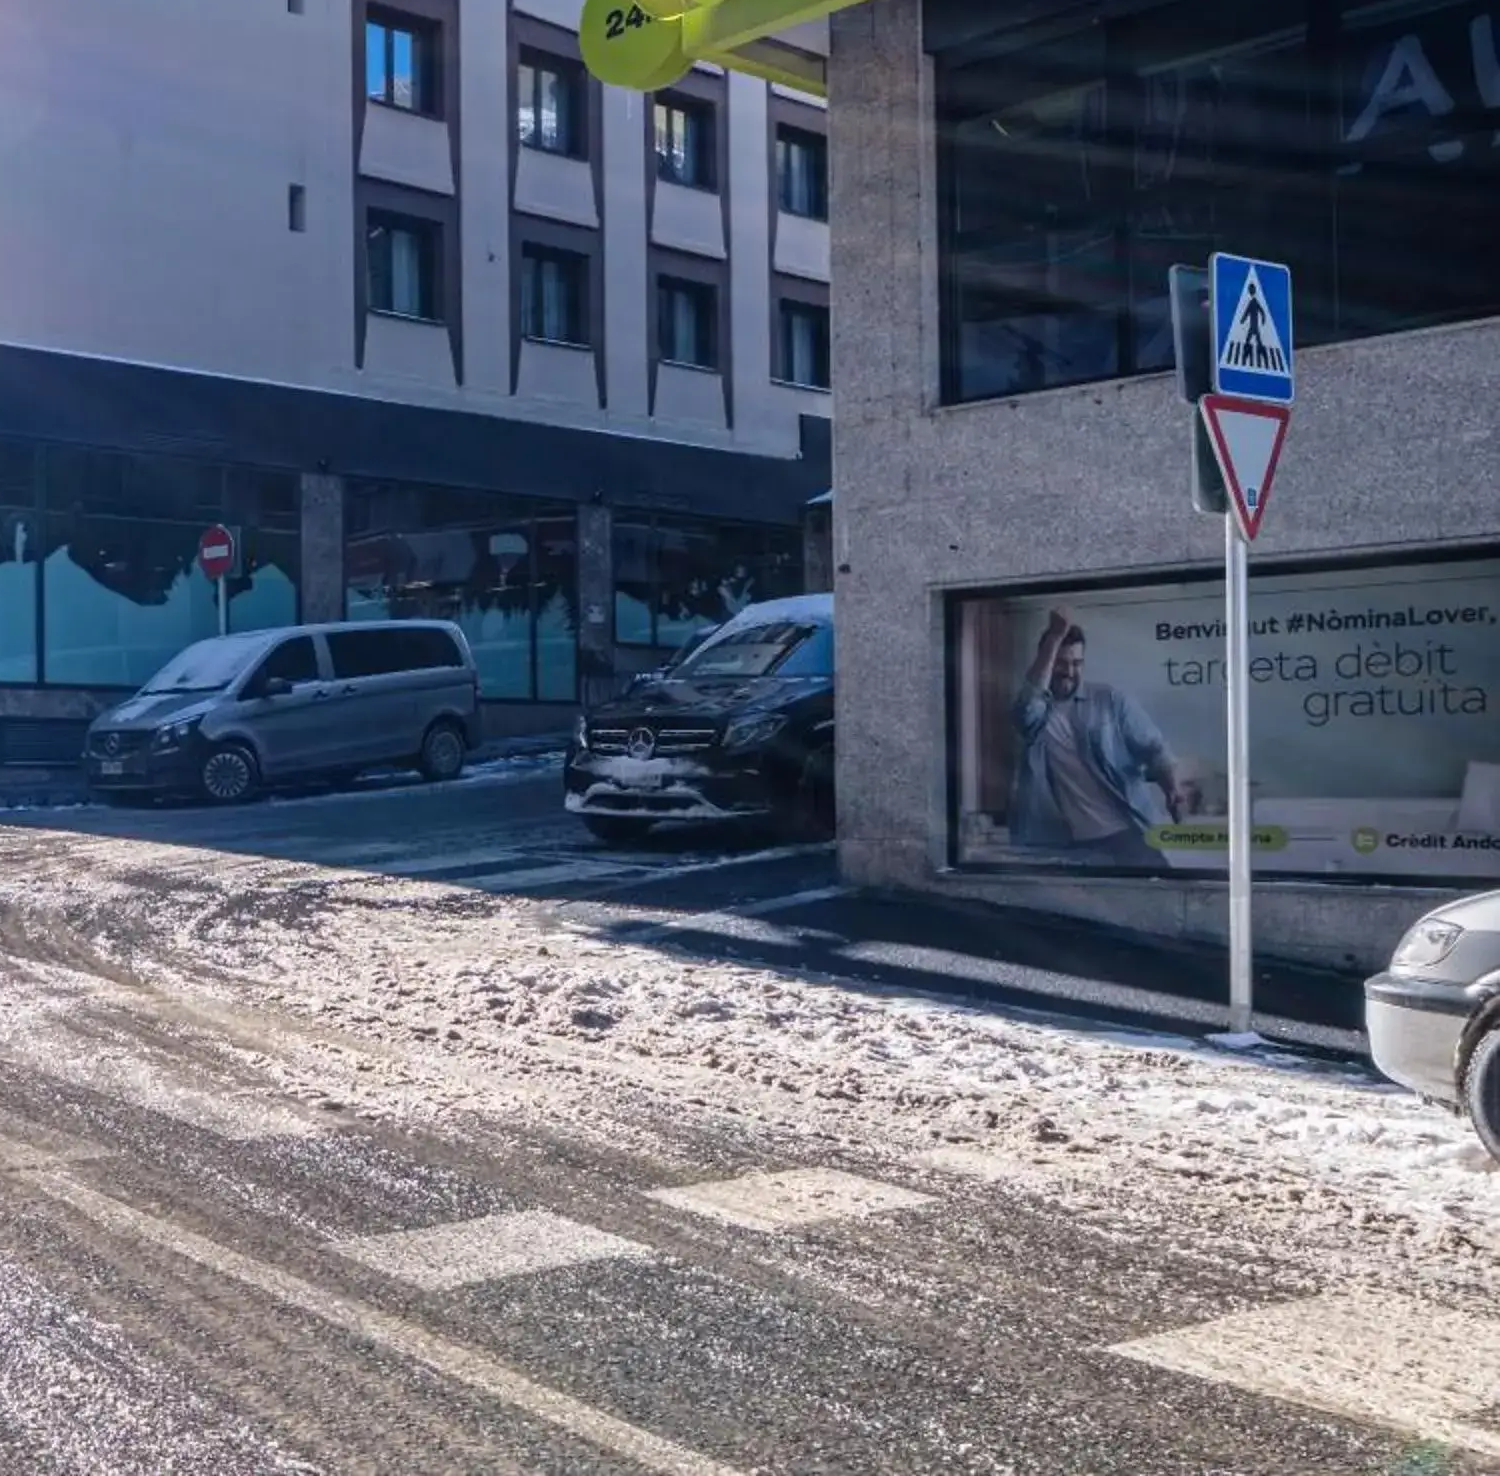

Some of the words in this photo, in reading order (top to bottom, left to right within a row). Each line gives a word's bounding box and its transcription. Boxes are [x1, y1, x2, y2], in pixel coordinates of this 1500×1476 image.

[605, 4, 652, 41] 24
[1155, 614, 1280, 641] Benviut
[1163, 651, 1317, 688] tareta
[1335, 640, 1457, 679] dèbit
